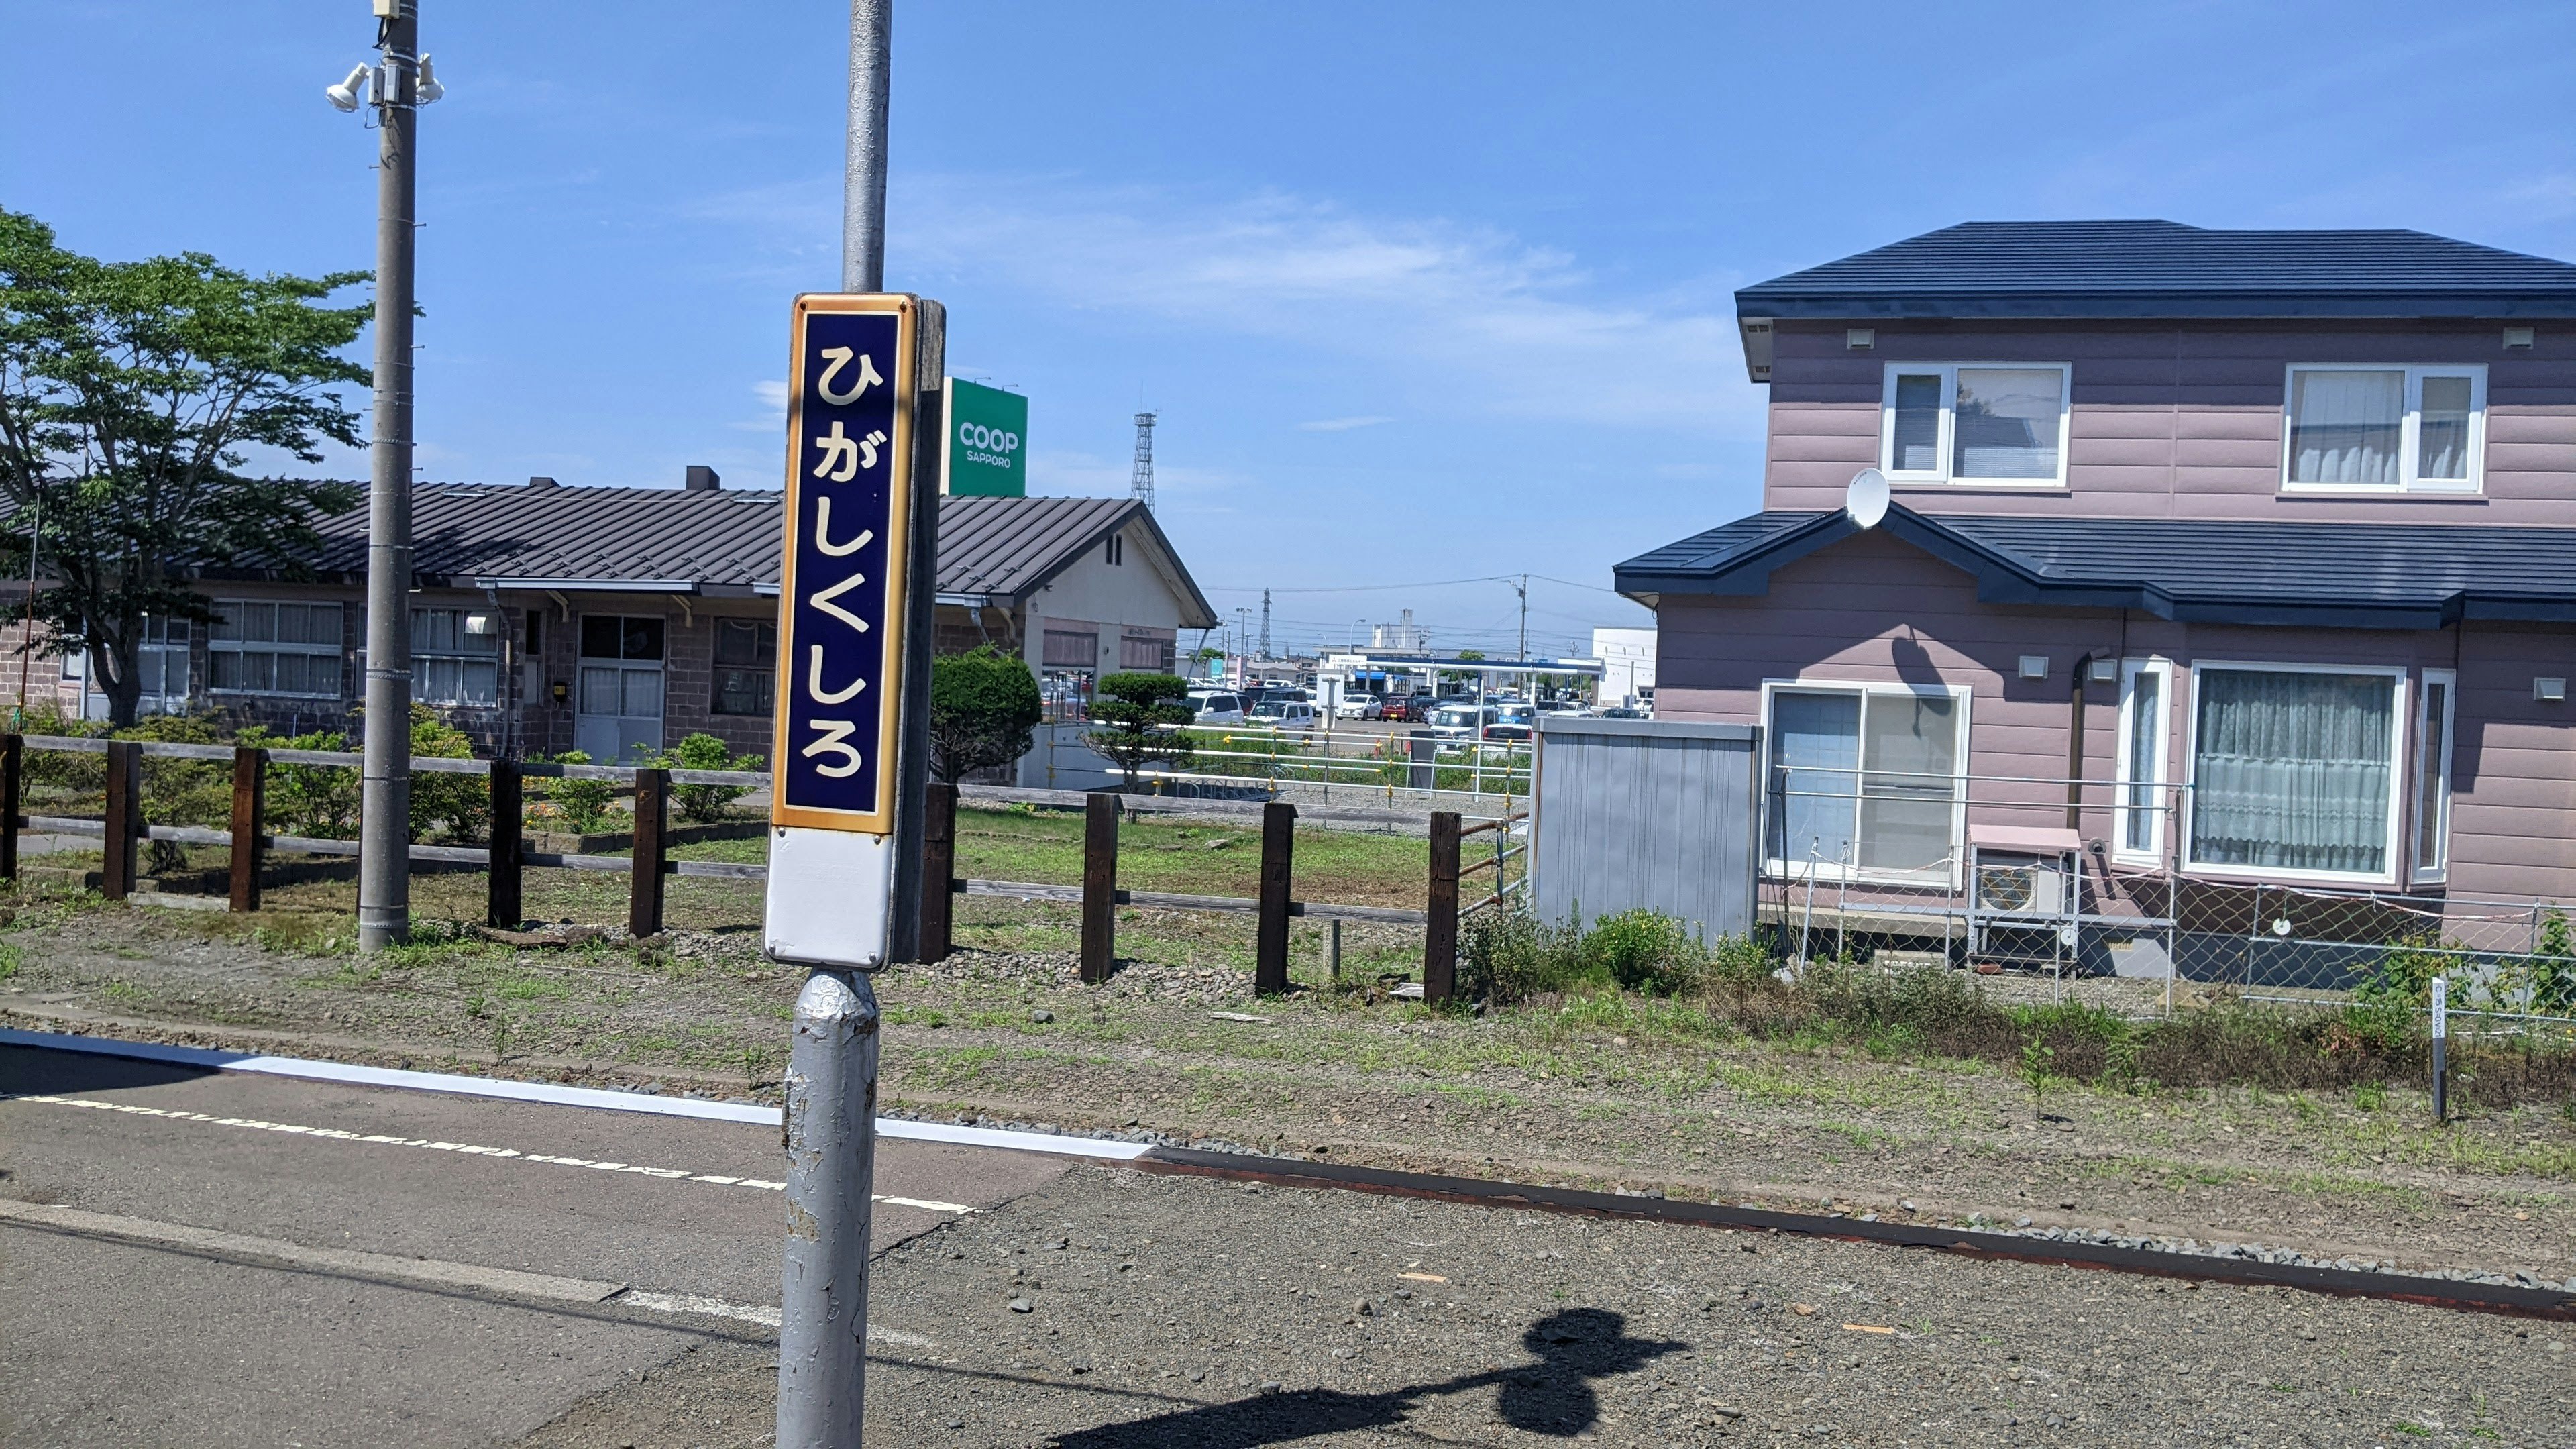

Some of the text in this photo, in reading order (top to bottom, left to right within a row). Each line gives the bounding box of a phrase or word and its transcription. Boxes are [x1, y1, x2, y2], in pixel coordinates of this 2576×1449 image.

[959, 422, 1018, 453] COOP
[967, 450, 1010, 468] SAPPORO
[802, 346, 886, 777] ひがしくしろ
